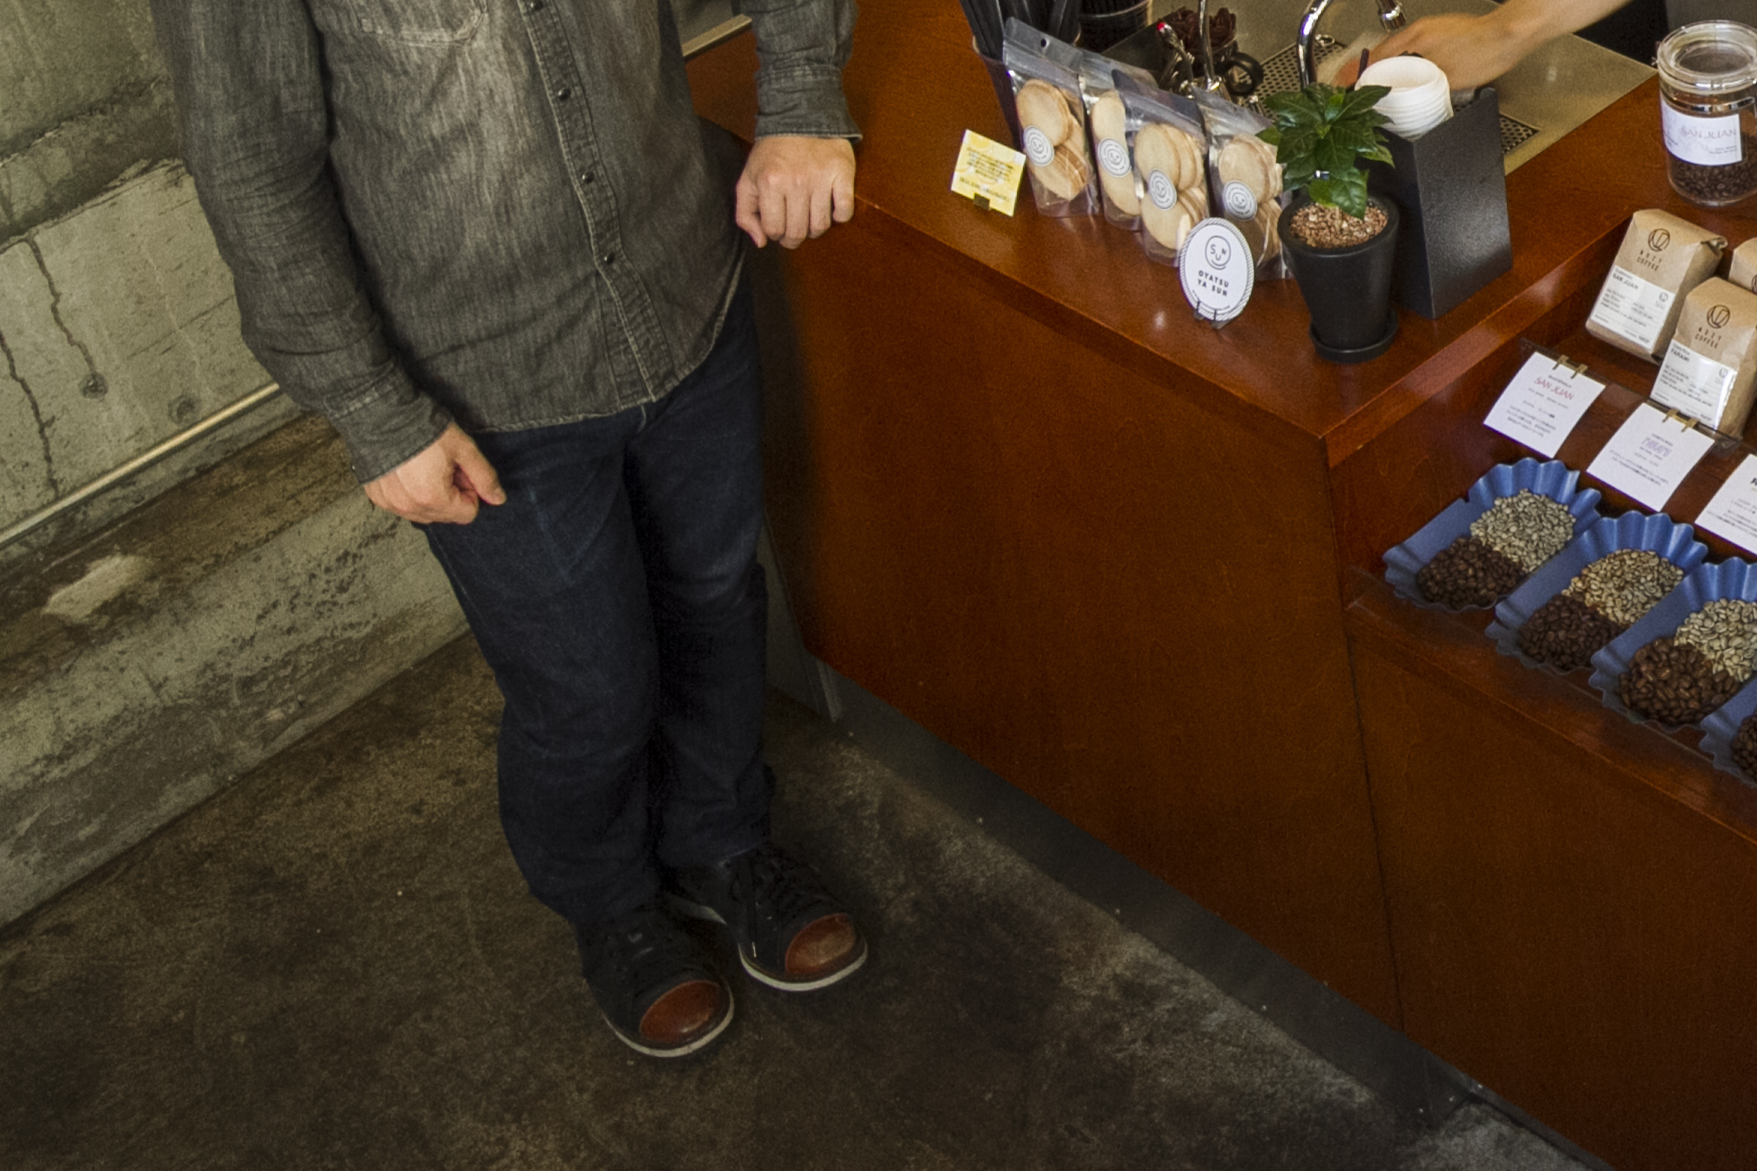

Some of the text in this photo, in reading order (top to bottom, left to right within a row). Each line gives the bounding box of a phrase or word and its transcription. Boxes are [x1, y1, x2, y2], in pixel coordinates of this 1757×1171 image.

[1681, 126, 1736, 140] SAN JUAN
[1636, 256, 1660, 272] COFFEE
[1197, 279, 1228, 297] YA SUN
[1198, 270, 1229, 288] OYATSU
[1612, 273, 1639, 291] SAN JUAN
[1694, 333, 1719, 349] COFFEE
[1534, 377, 1575, 401] SAN JUAN
